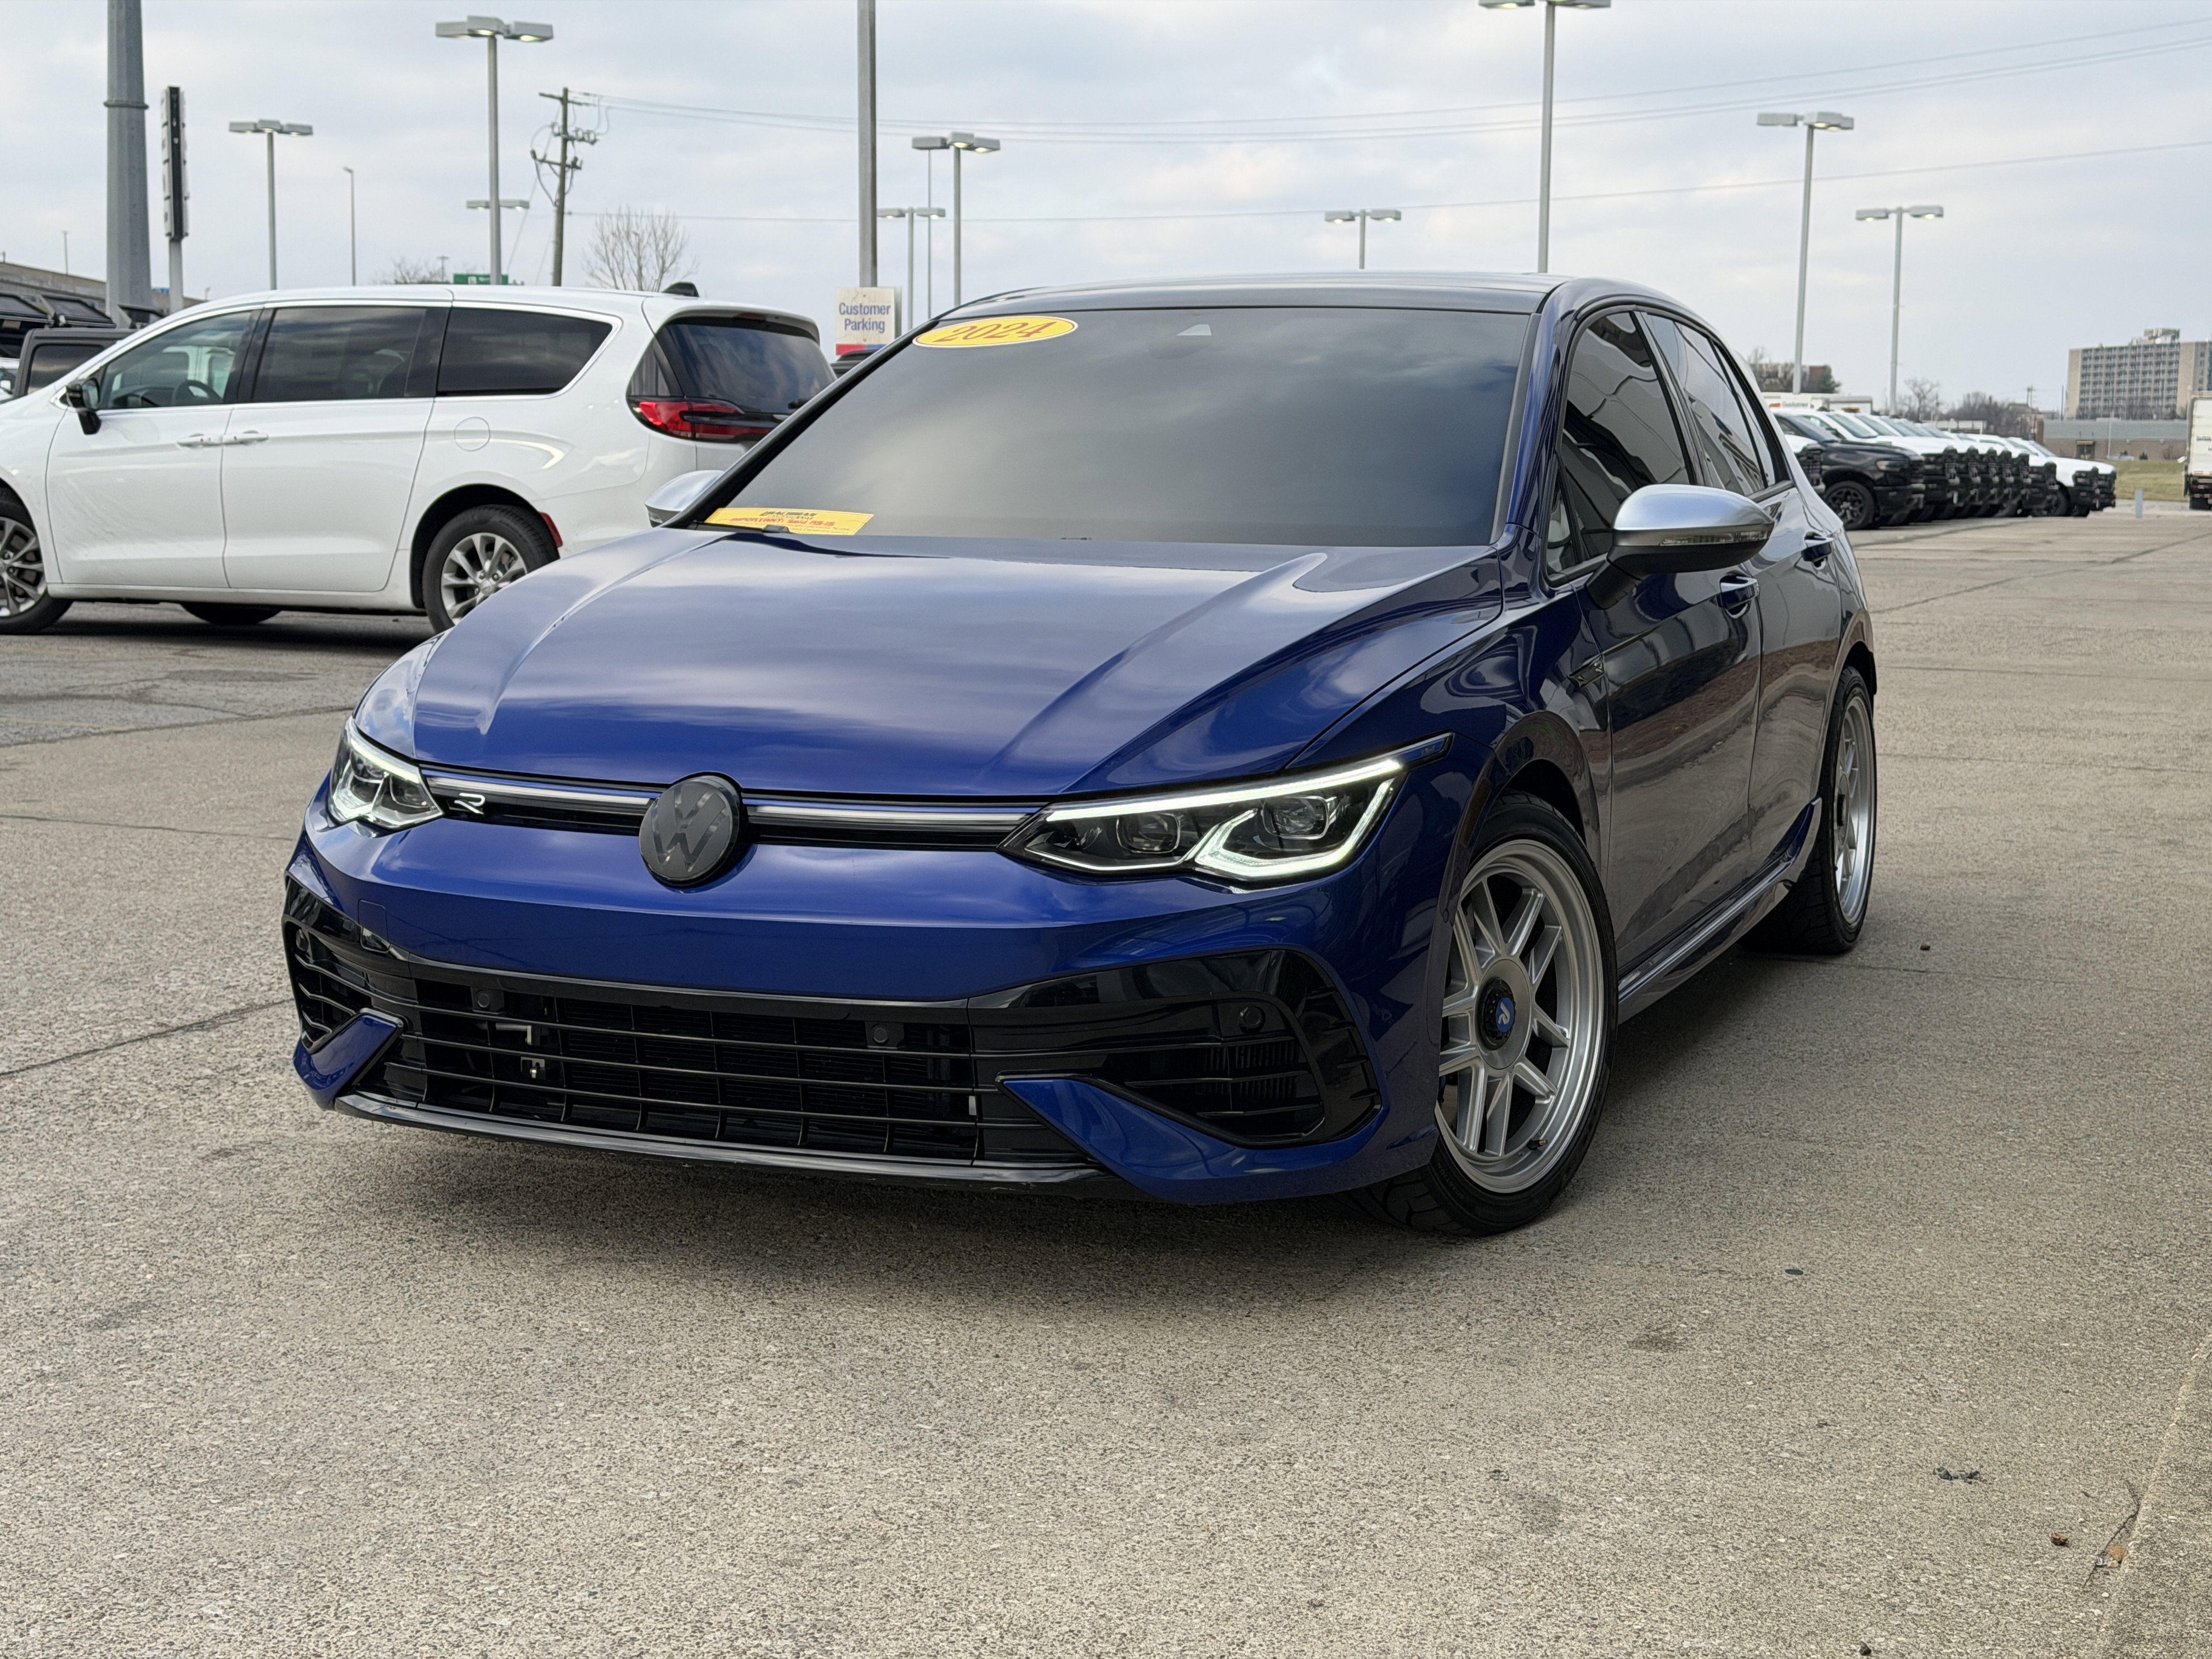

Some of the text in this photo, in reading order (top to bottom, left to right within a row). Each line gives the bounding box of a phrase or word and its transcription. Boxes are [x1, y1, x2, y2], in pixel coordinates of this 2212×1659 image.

[839, 302, 891, 315] Customer
[844, 318, 885, 334] Parking
[932, 321, 1057, 342] 2024
[454, 792, 486, 815] R
[651, 785, 731, 872] VW
